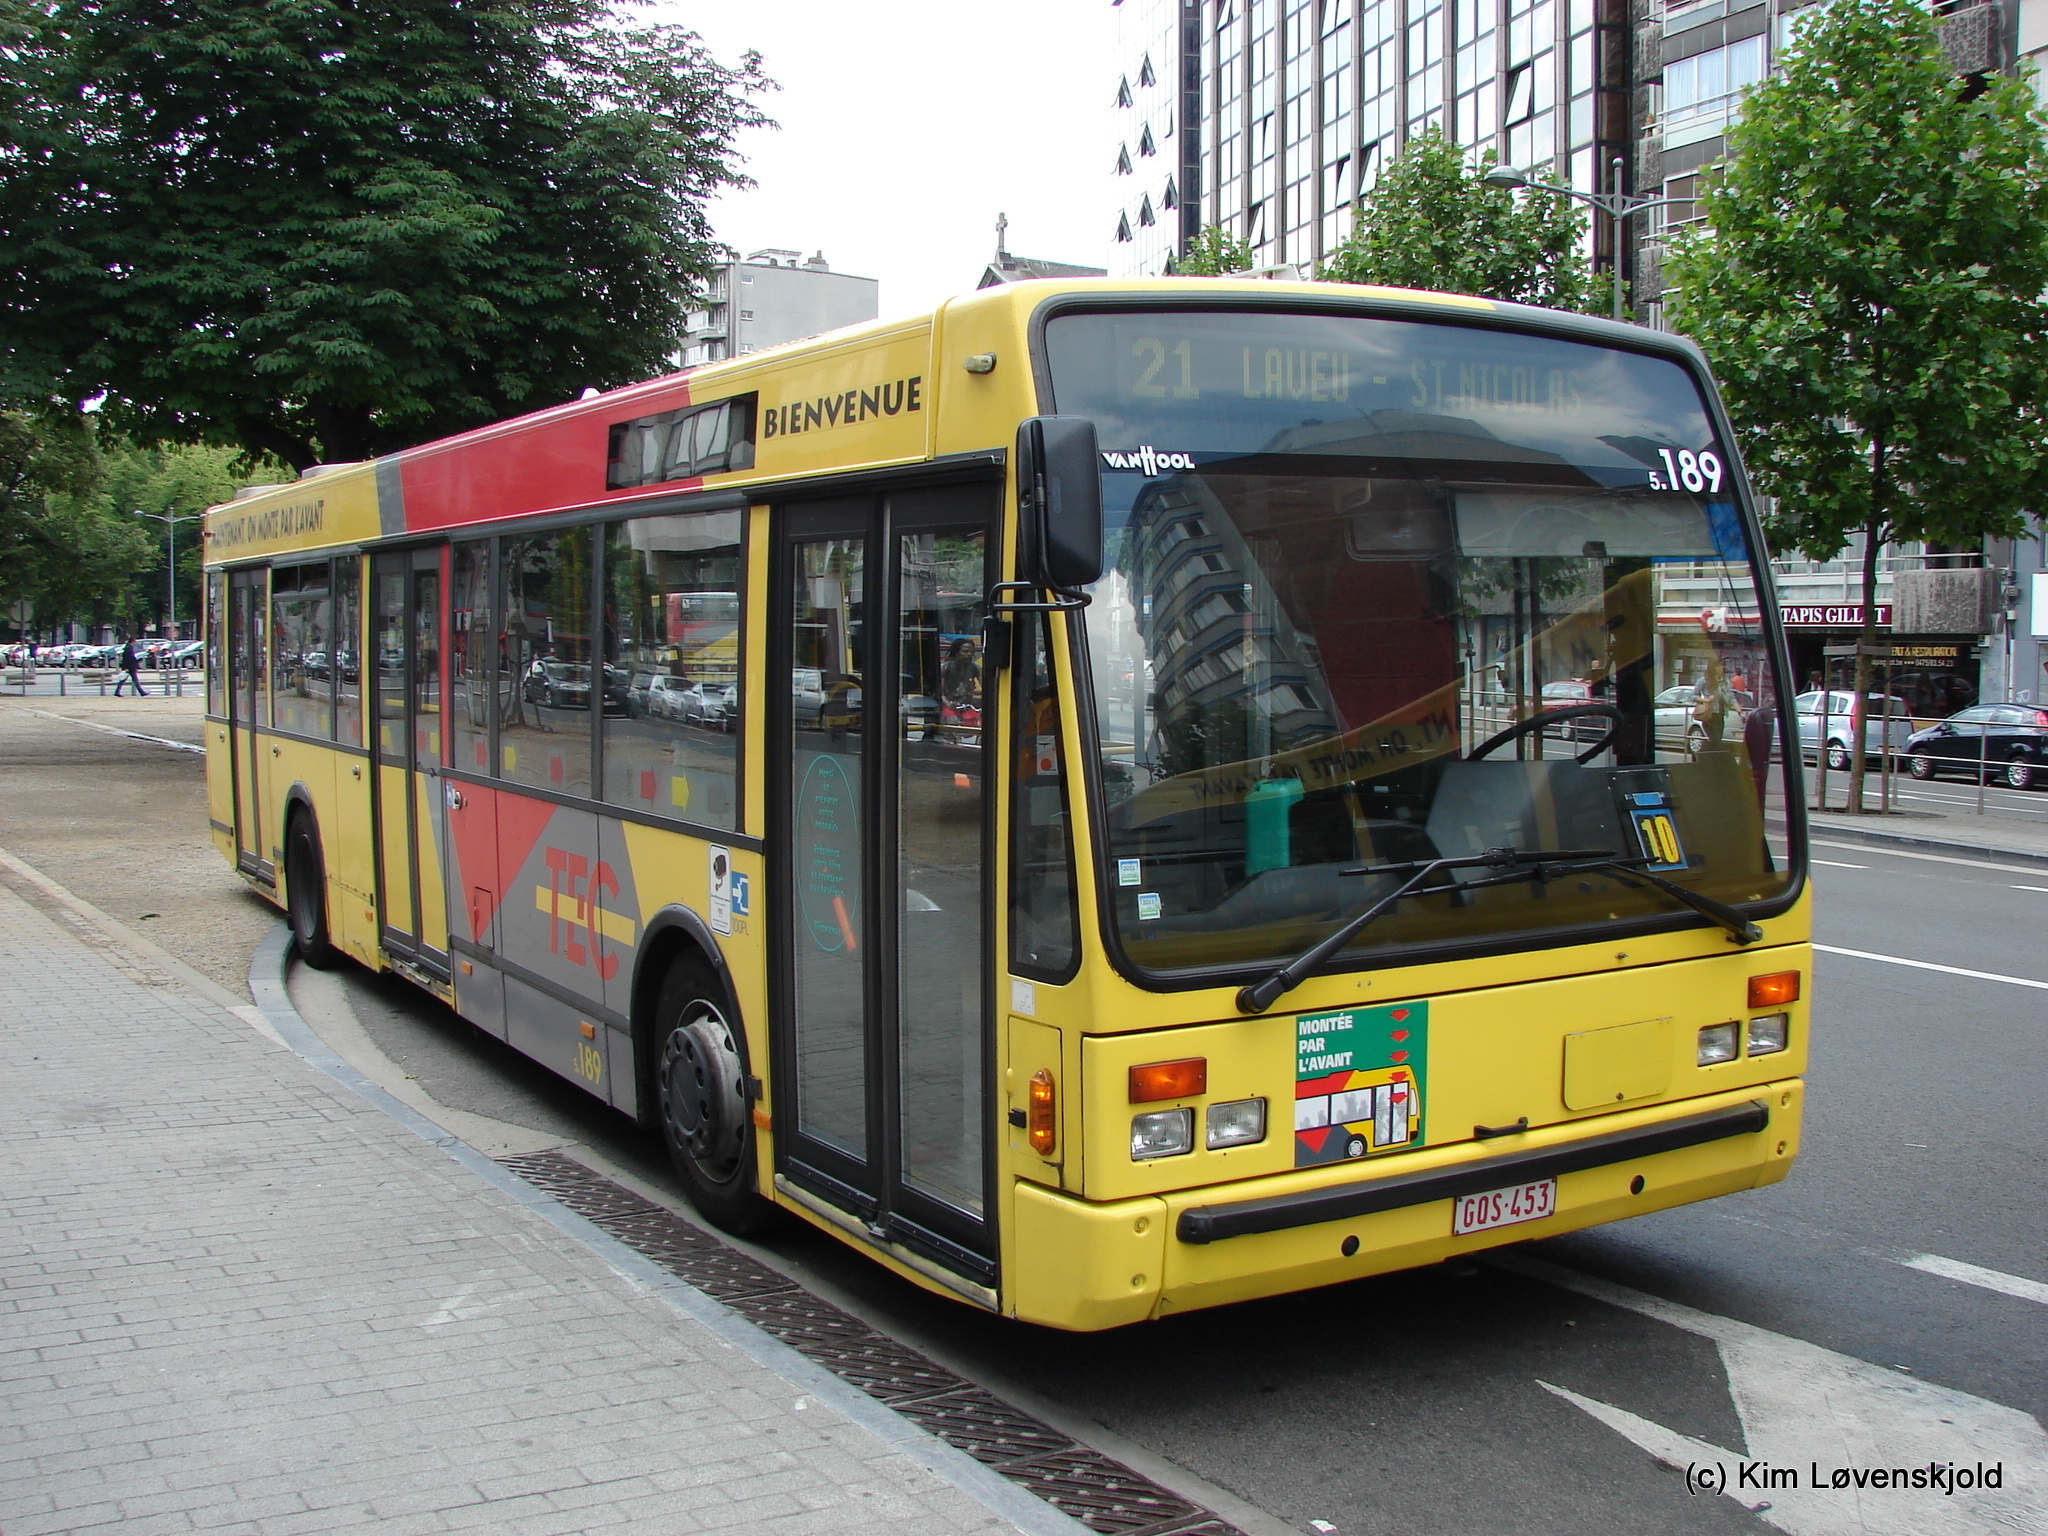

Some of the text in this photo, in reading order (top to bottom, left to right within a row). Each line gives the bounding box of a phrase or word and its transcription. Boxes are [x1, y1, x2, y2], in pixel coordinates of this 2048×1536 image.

[1131, 337, 1200, 399] 21
[1242, 346, 1350, 402] LAVEU
[764, 376, 921, 439] BIENVENUE
[280, 506, 294, 538] PAR
[1781, 607, 1886, 623] TAPIS GILLT
[1641, 816, 1680, 863] 10
[544, 846, 620, 981] TEC
[1298, 1013, 1353, 1036] MONTÉE
[1298, 1037, 1326, 1054] PAR
[1298, 1052, 1353, 1073] L'AVANT
